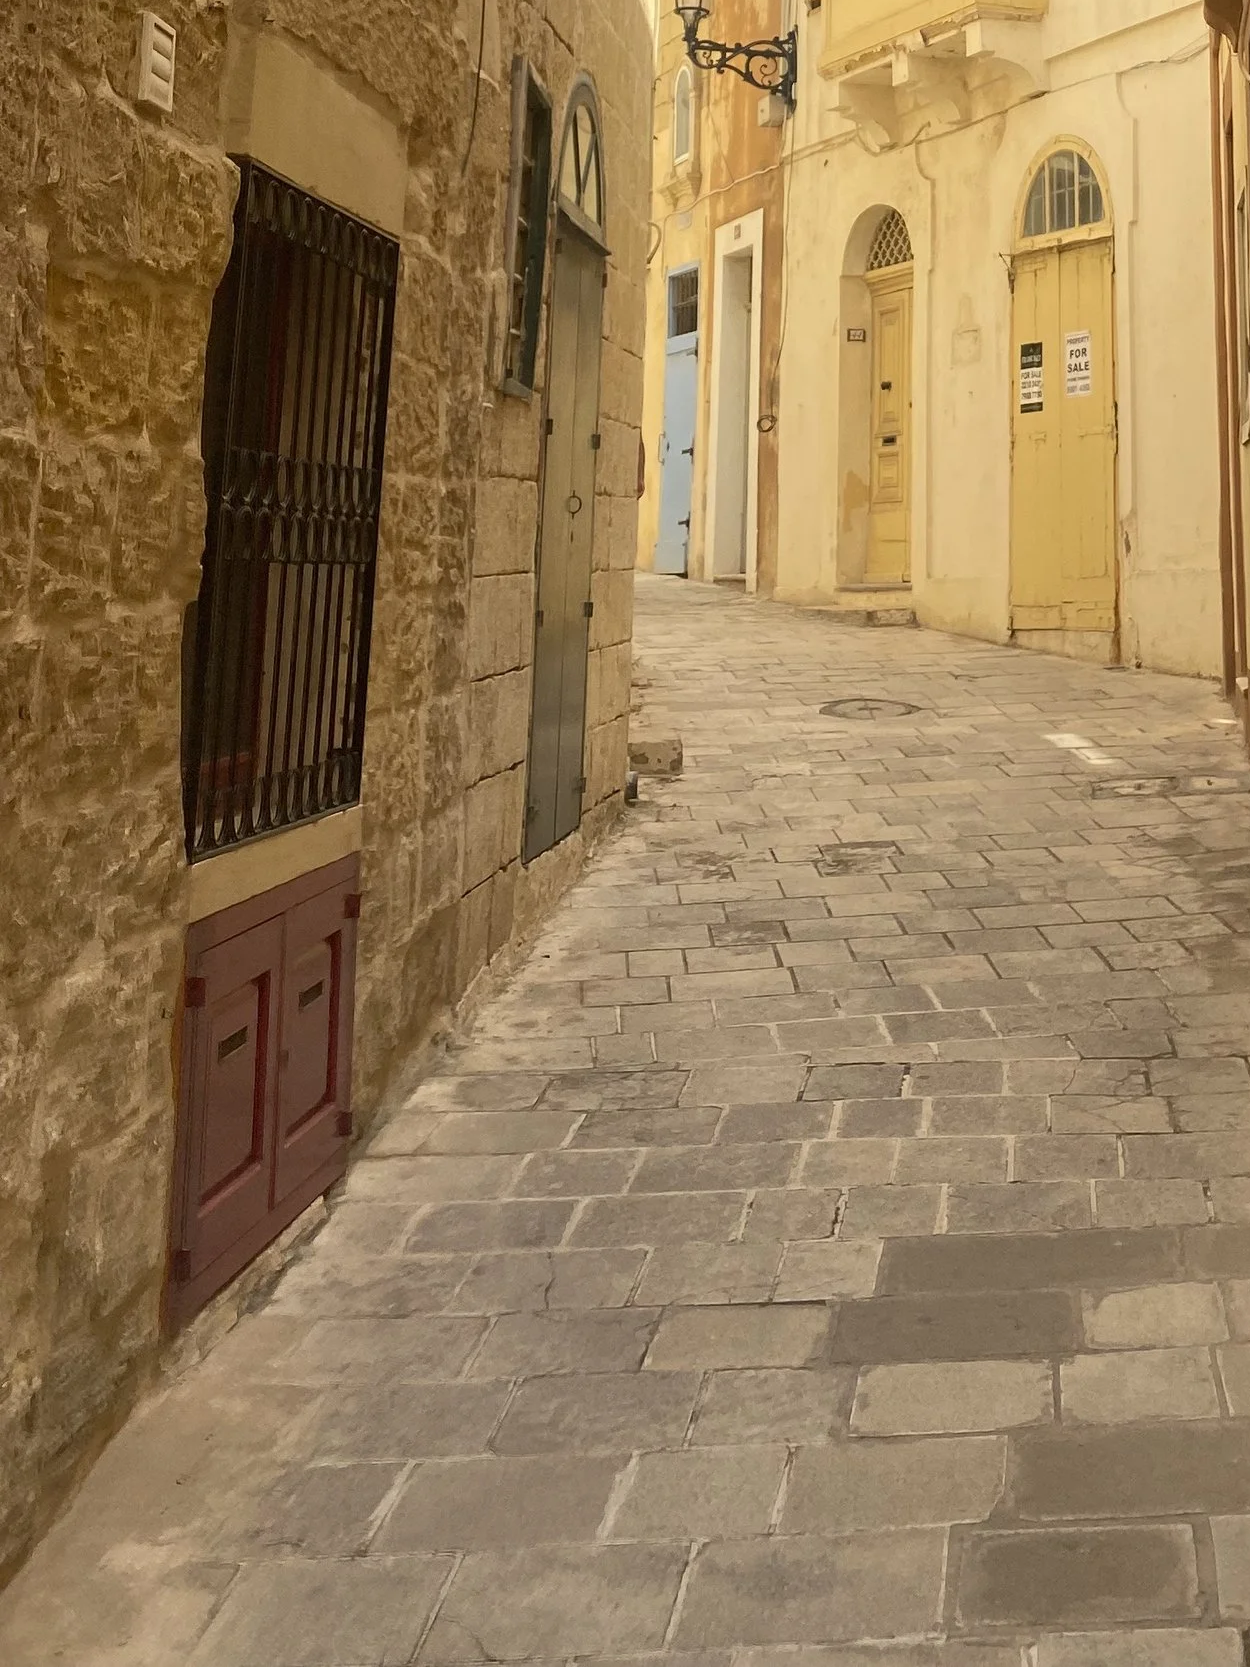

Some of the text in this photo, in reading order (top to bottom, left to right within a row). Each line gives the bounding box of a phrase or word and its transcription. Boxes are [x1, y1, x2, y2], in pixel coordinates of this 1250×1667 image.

[1067, 335, 1089, 344] PROPERTY
[1069, 347, 1087, 359] FOR
[1067, 361, 1089, 373] SALE
[1021, 370, 1041, 379] FOR SALE
